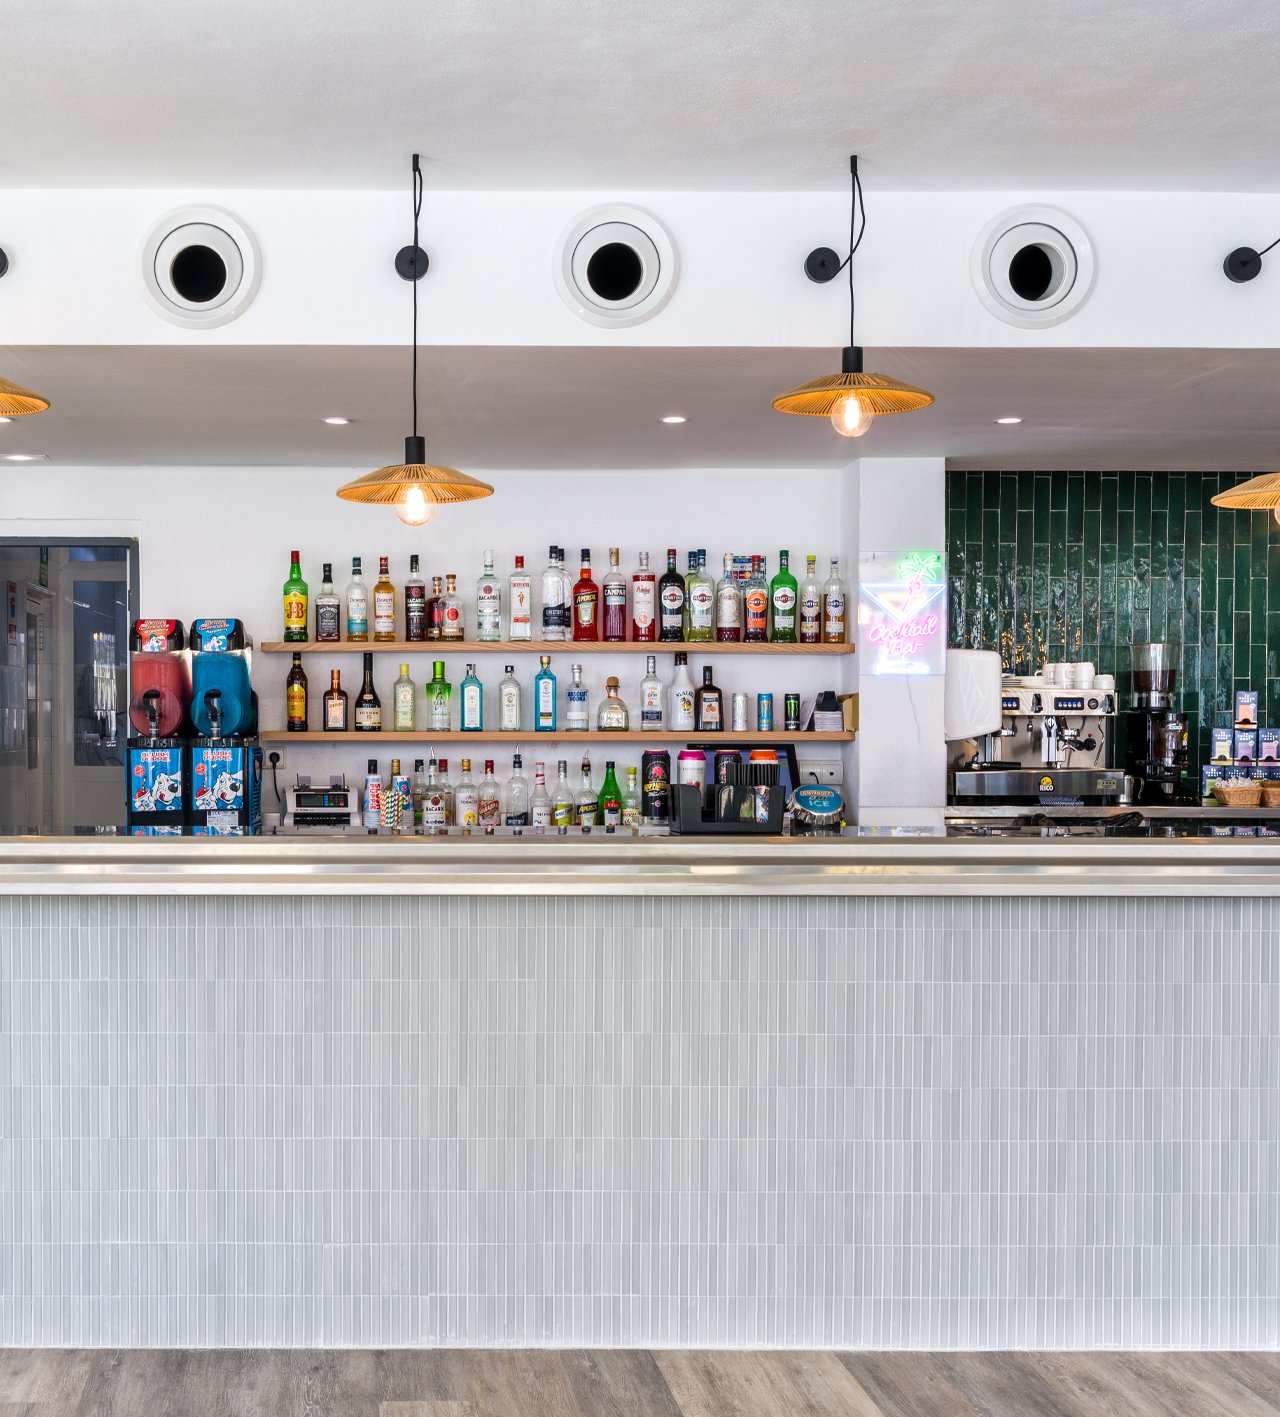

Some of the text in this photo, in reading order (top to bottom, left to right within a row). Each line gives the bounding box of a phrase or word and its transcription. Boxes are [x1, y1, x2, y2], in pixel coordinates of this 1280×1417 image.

[576, 594, 596, 603] APEROL
[869, 615, 938, 642] Cocktail
[887, 640, 923, 656] Bar
